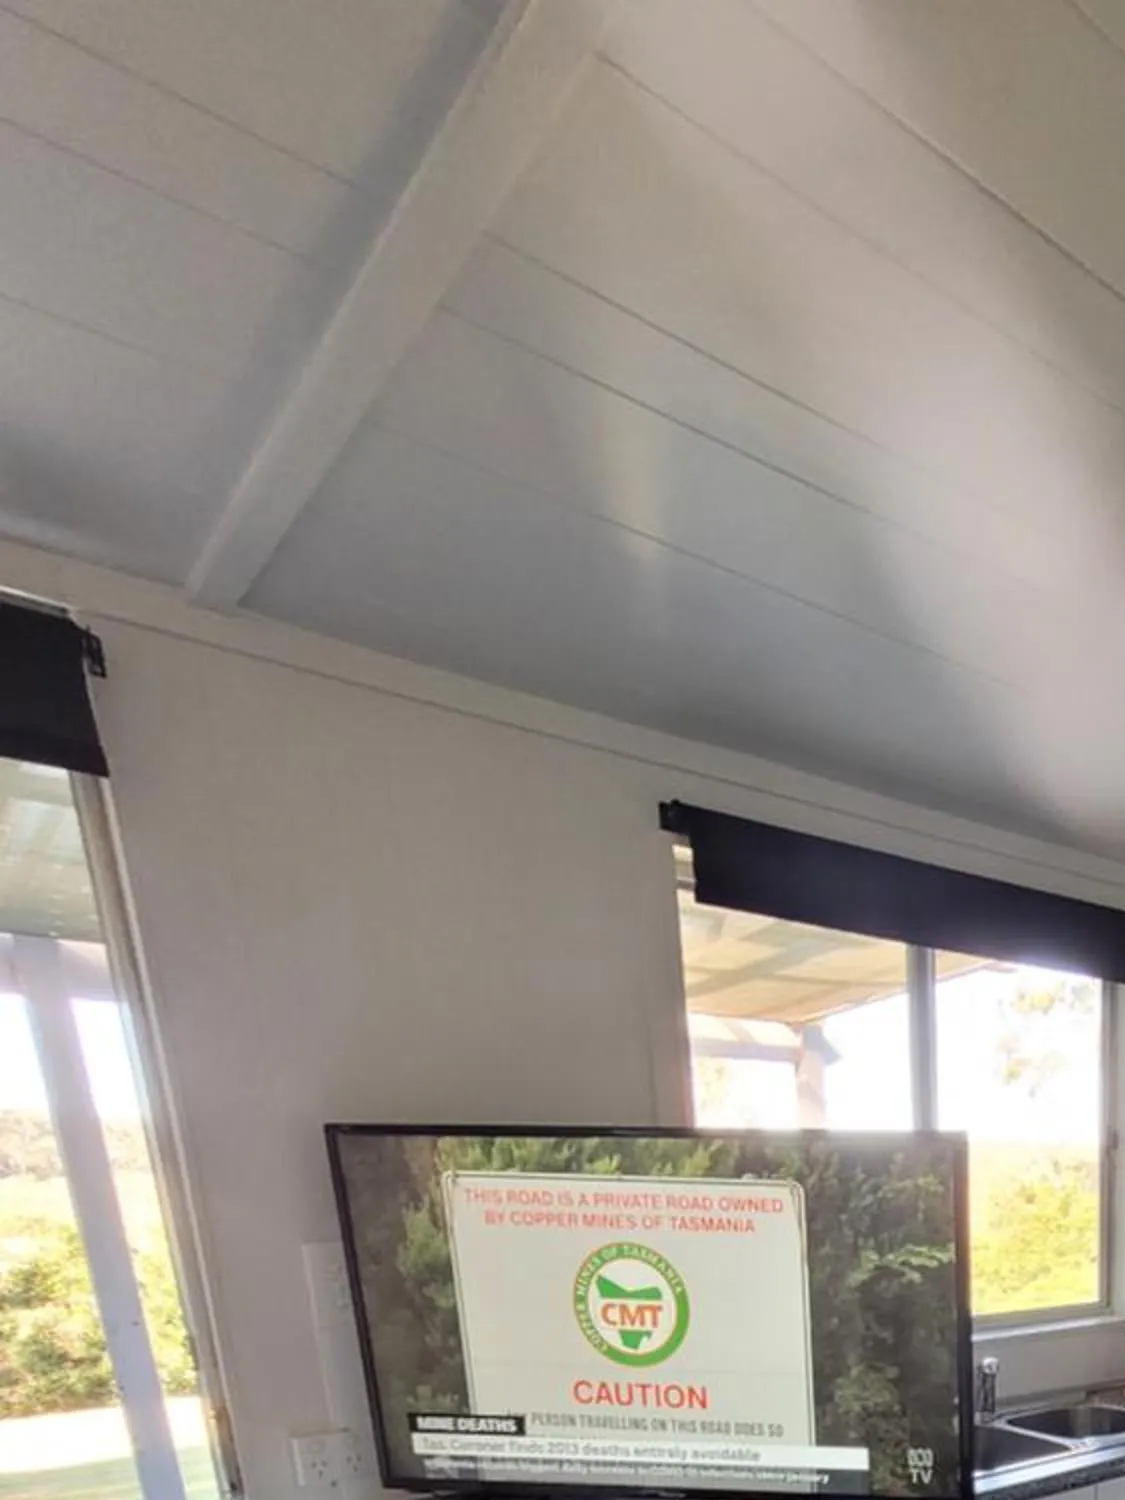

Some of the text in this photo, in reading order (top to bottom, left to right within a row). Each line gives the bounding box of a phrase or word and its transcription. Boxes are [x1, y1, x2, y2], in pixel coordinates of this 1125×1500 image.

[464, 1187, 784, 1213] THIS ROAD IS A PRIVATE ROAD OWNED
[484, 1209, 756, 1233] BY COPPER MINES OF TASMANIA
[600, 1303, 663, 1328] CMT
[572, 1379, 709, 1410] CAUTION
[415, 1416, 518, 1433] MINE DEATHS
[531, 1411, 785, 1438] PERSON TRAVELLING ON THIS ROAD DOES SO
